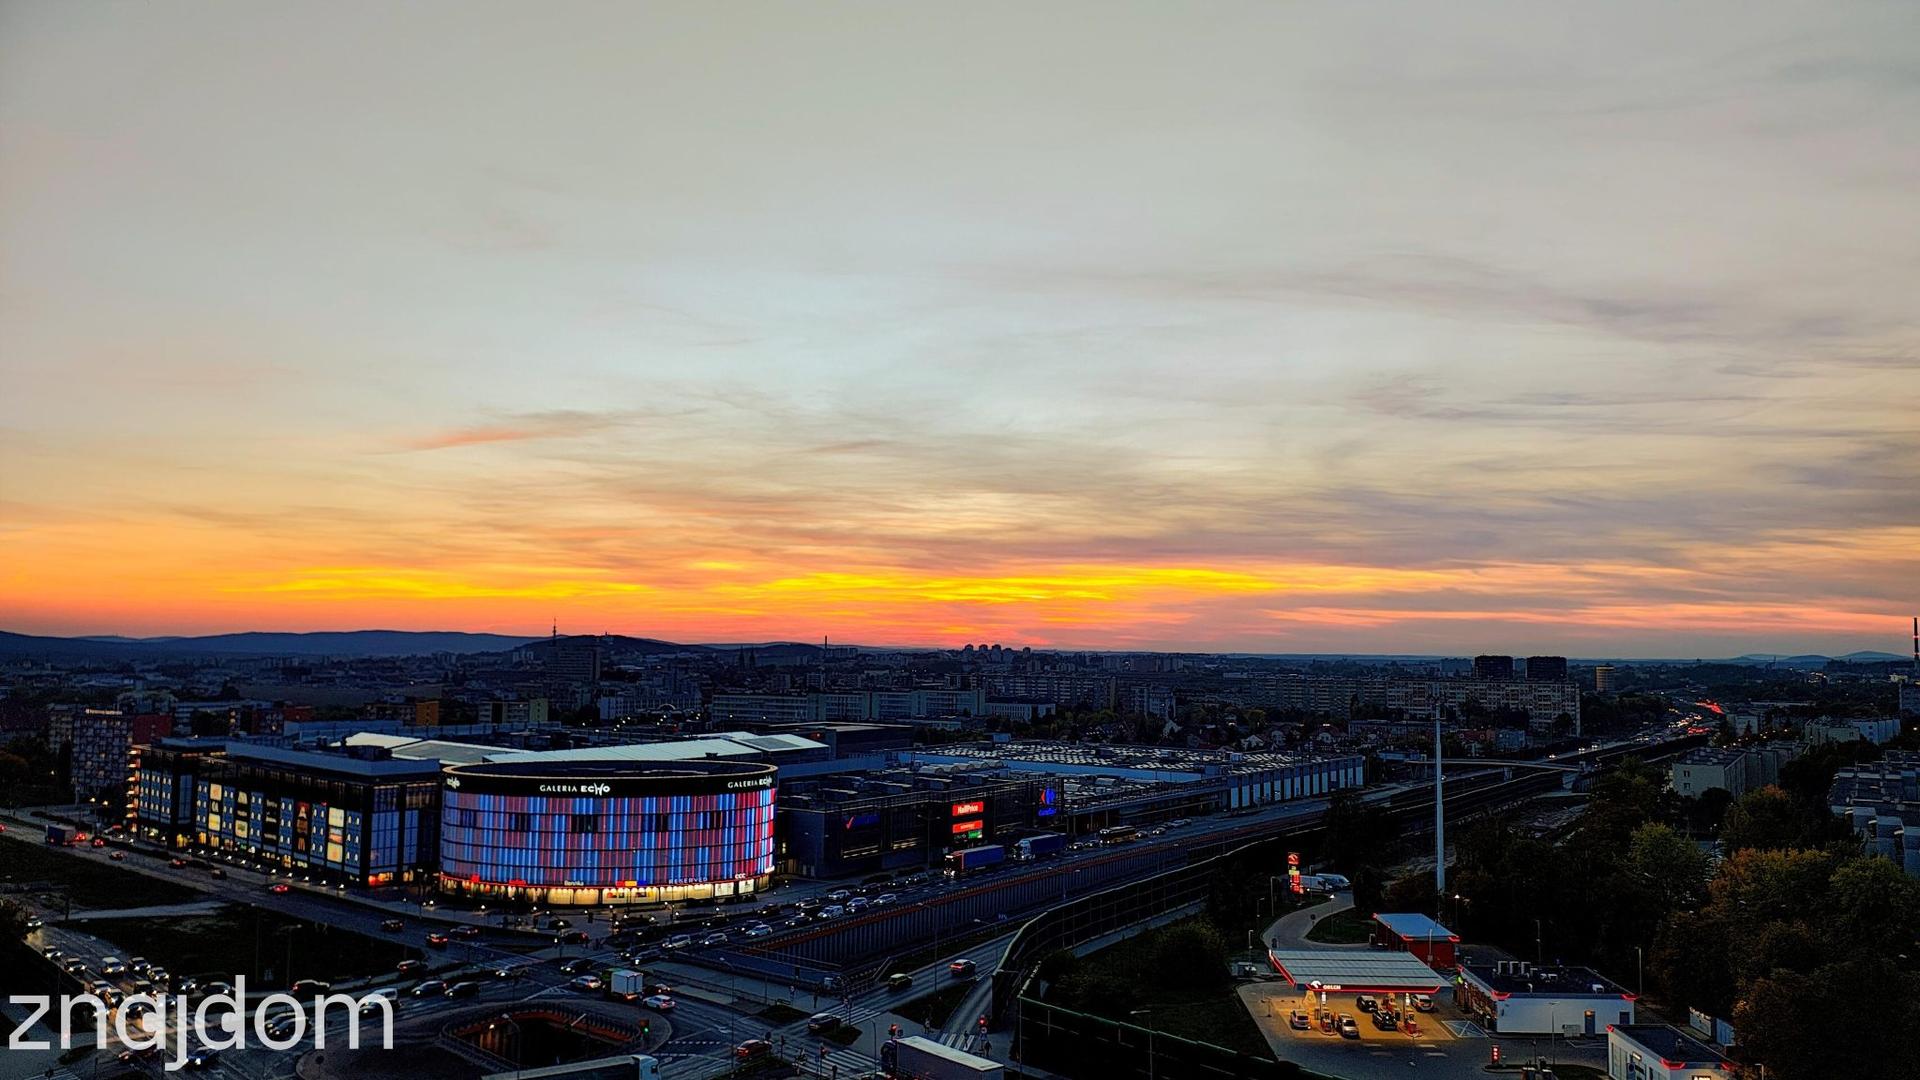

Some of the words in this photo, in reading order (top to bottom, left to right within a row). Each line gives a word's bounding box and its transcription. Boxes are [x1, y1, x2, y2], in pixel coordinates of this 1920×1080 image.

[539, 784, 577, 792] GALERIA
[580, 782, 611, 796] ECHO
[668, 877, 708, 885] RESERVED
